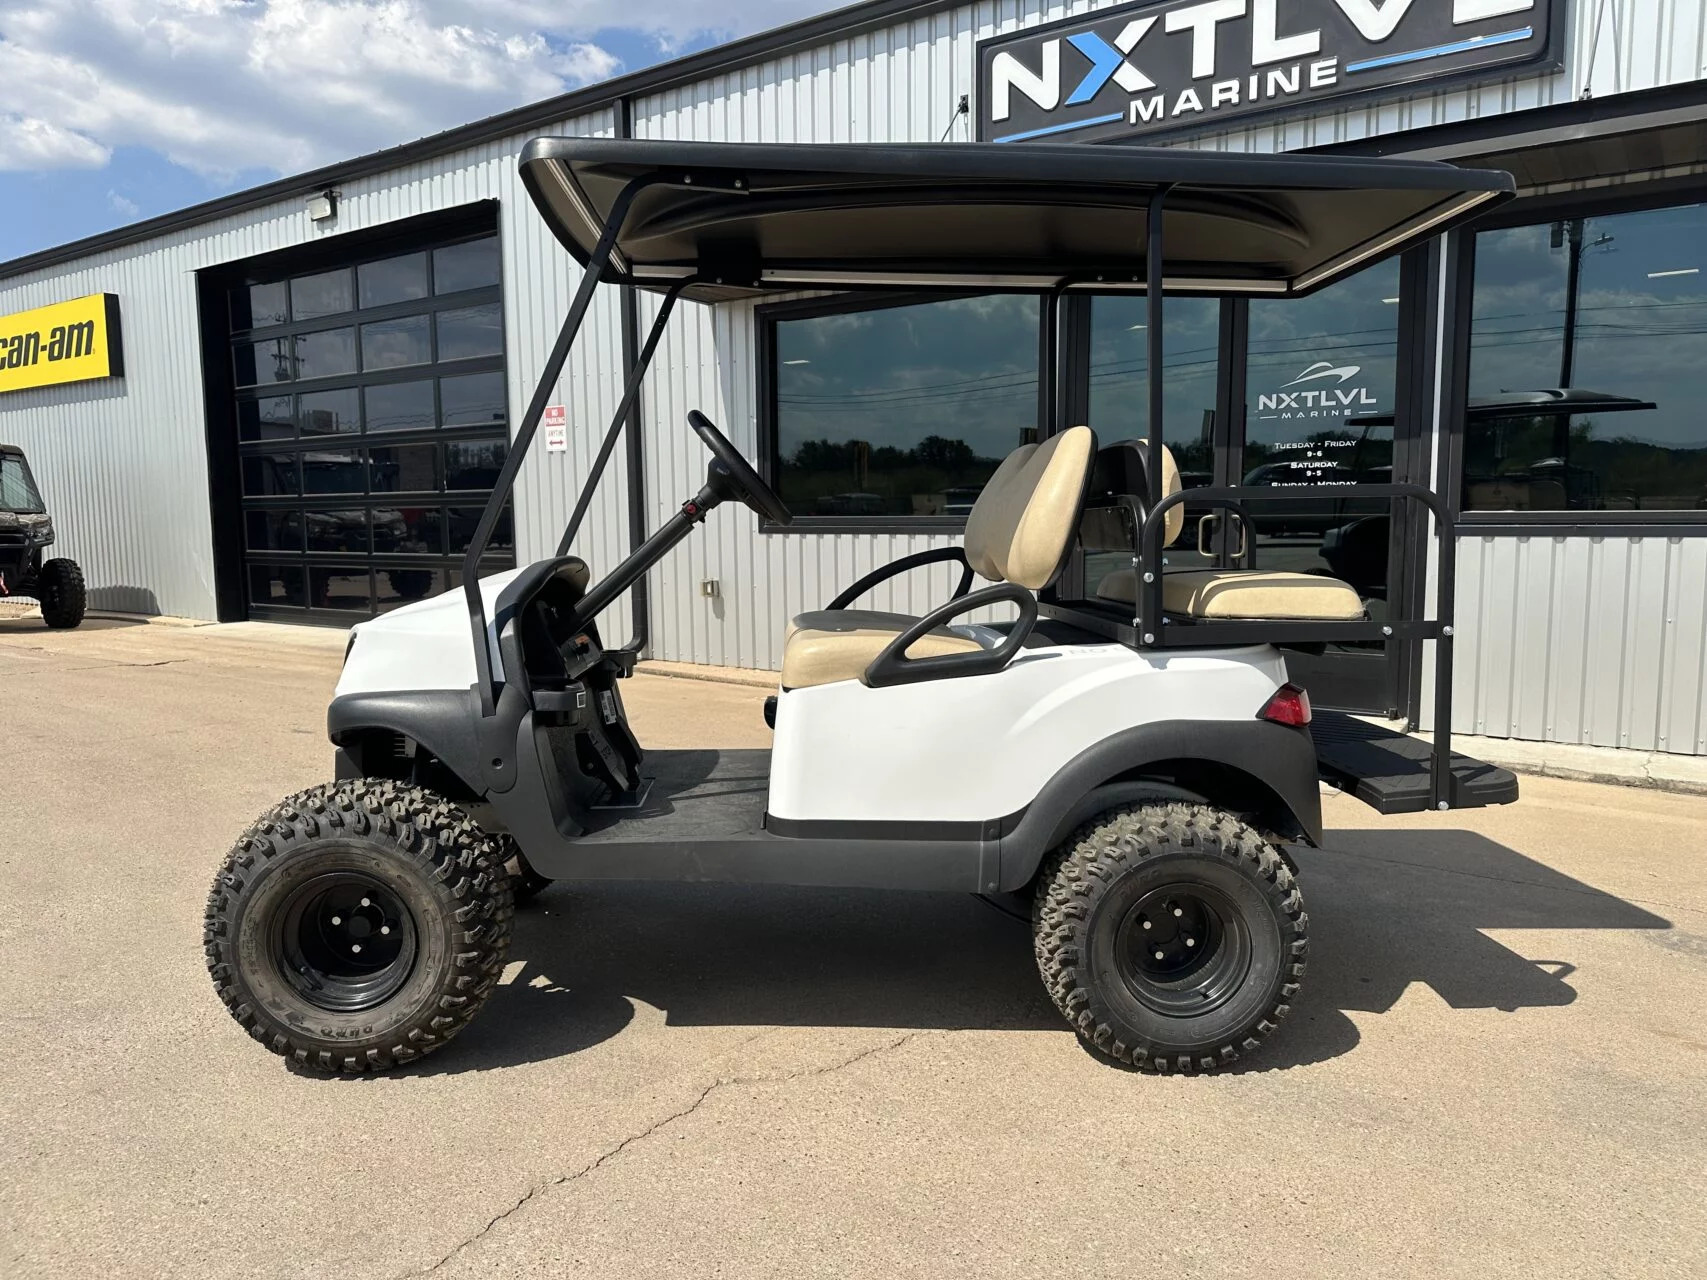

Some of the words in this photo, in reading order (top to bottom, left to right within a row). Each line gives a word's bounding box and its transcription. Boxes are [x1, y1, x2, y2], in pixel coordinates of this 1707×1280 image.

[1129, 56, 1338, 124] MARINE
[1258, 387, 1377, 410] NXTLVL
[1281, 408, 1352, 419] MARINE
